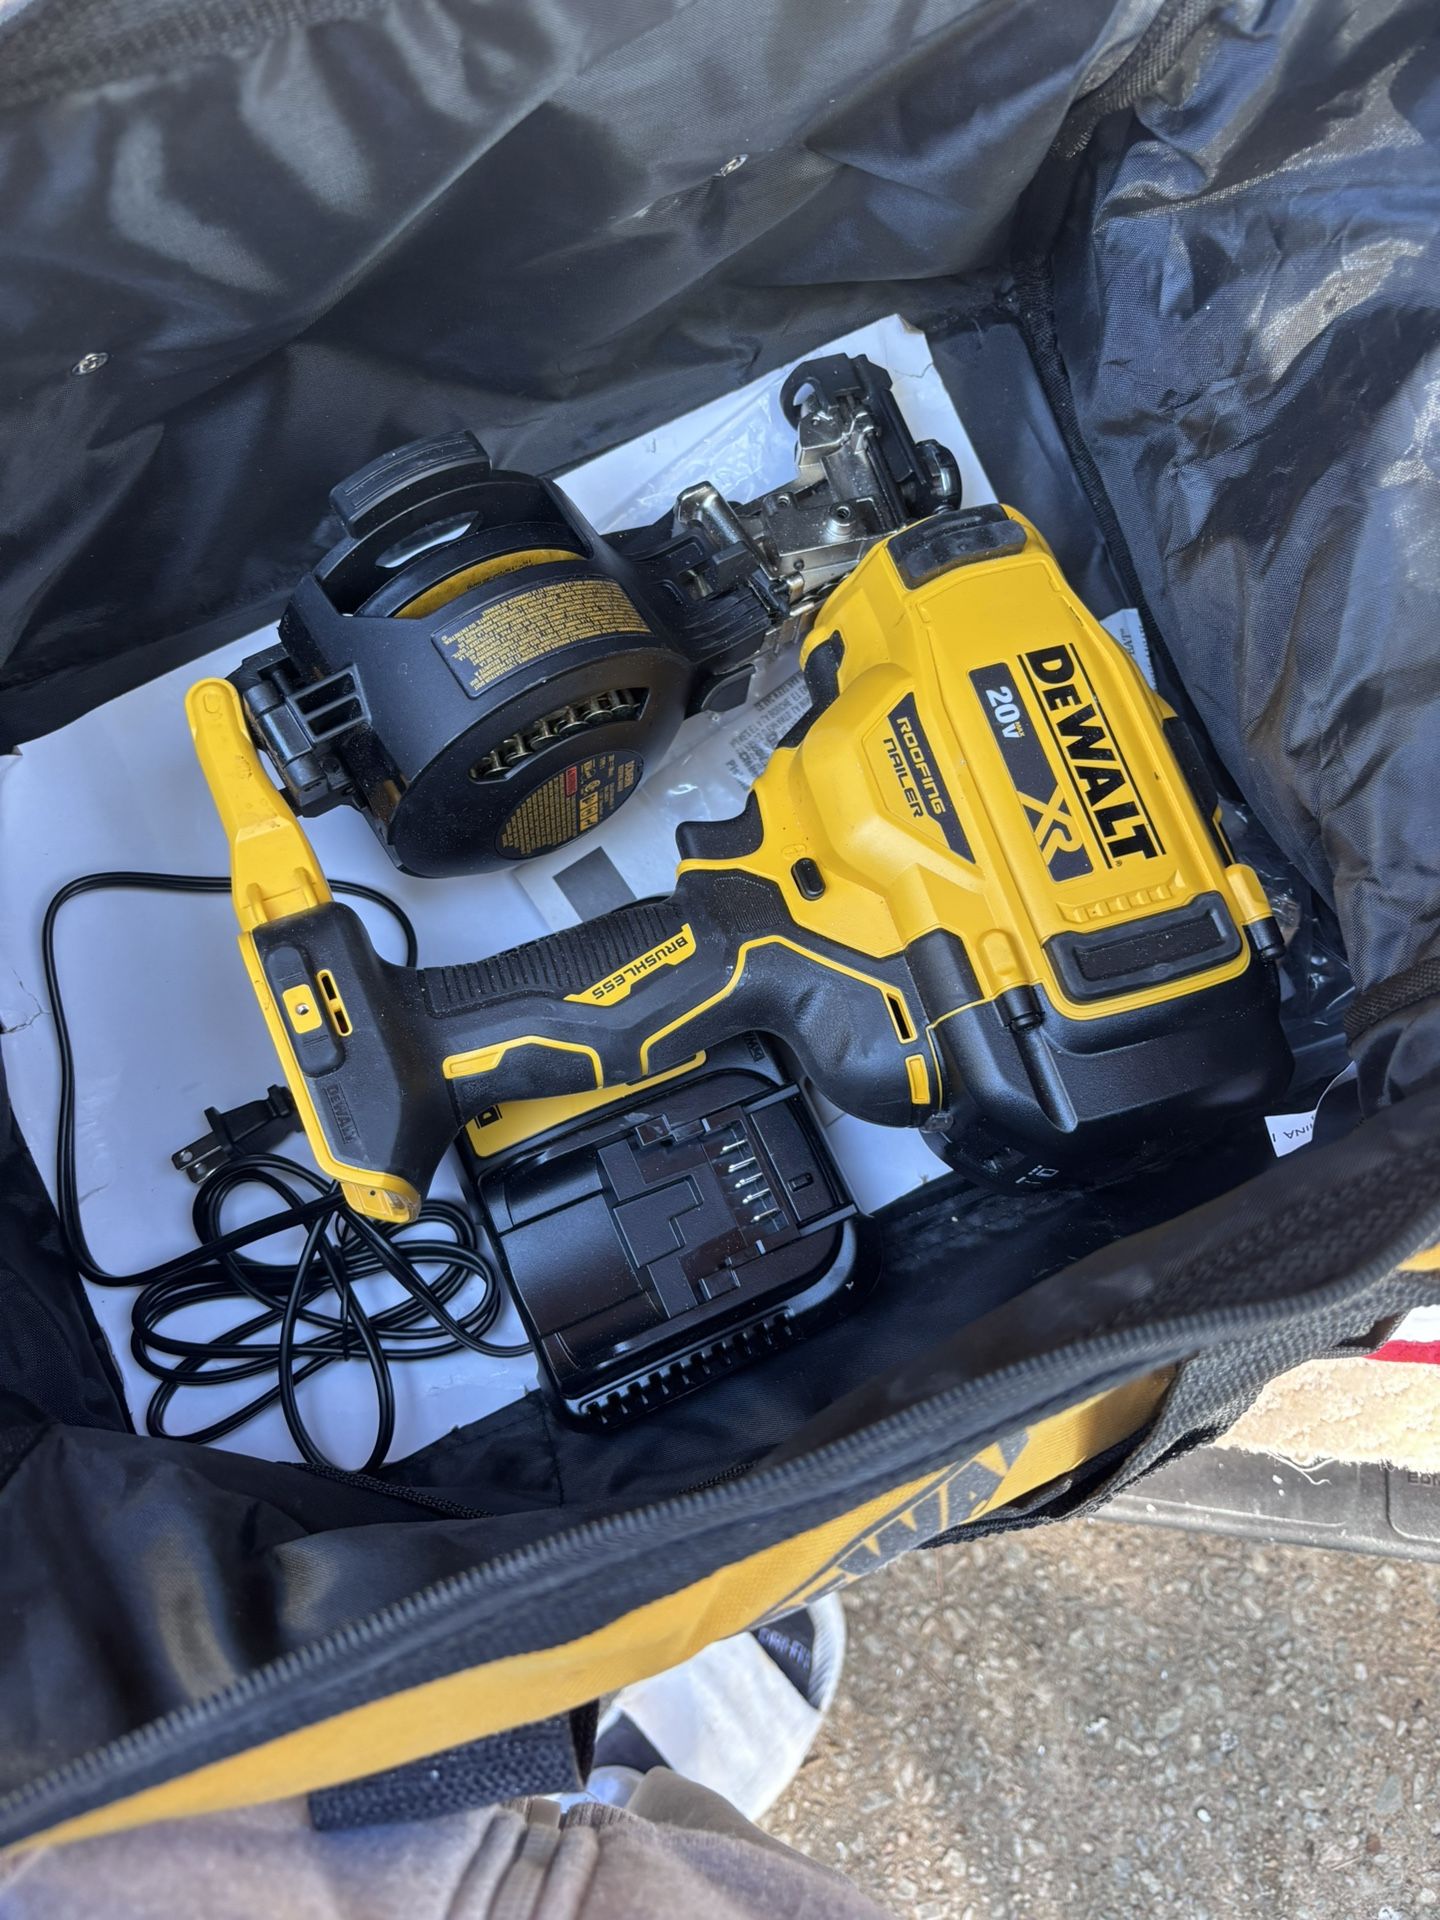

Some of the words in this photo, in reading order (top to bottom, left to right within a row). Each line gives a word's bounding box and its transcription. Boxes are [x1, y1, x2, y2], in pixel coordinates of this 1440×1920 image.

[883, 737, 924, 818] NAILER
[896, 717, 946, 815] ROOFING
[1025, 644, 1159, 860] DEWALT
[1017, 782, 1083, 865] XR
[591, 936, 689, 1000] BRUSHLESS
